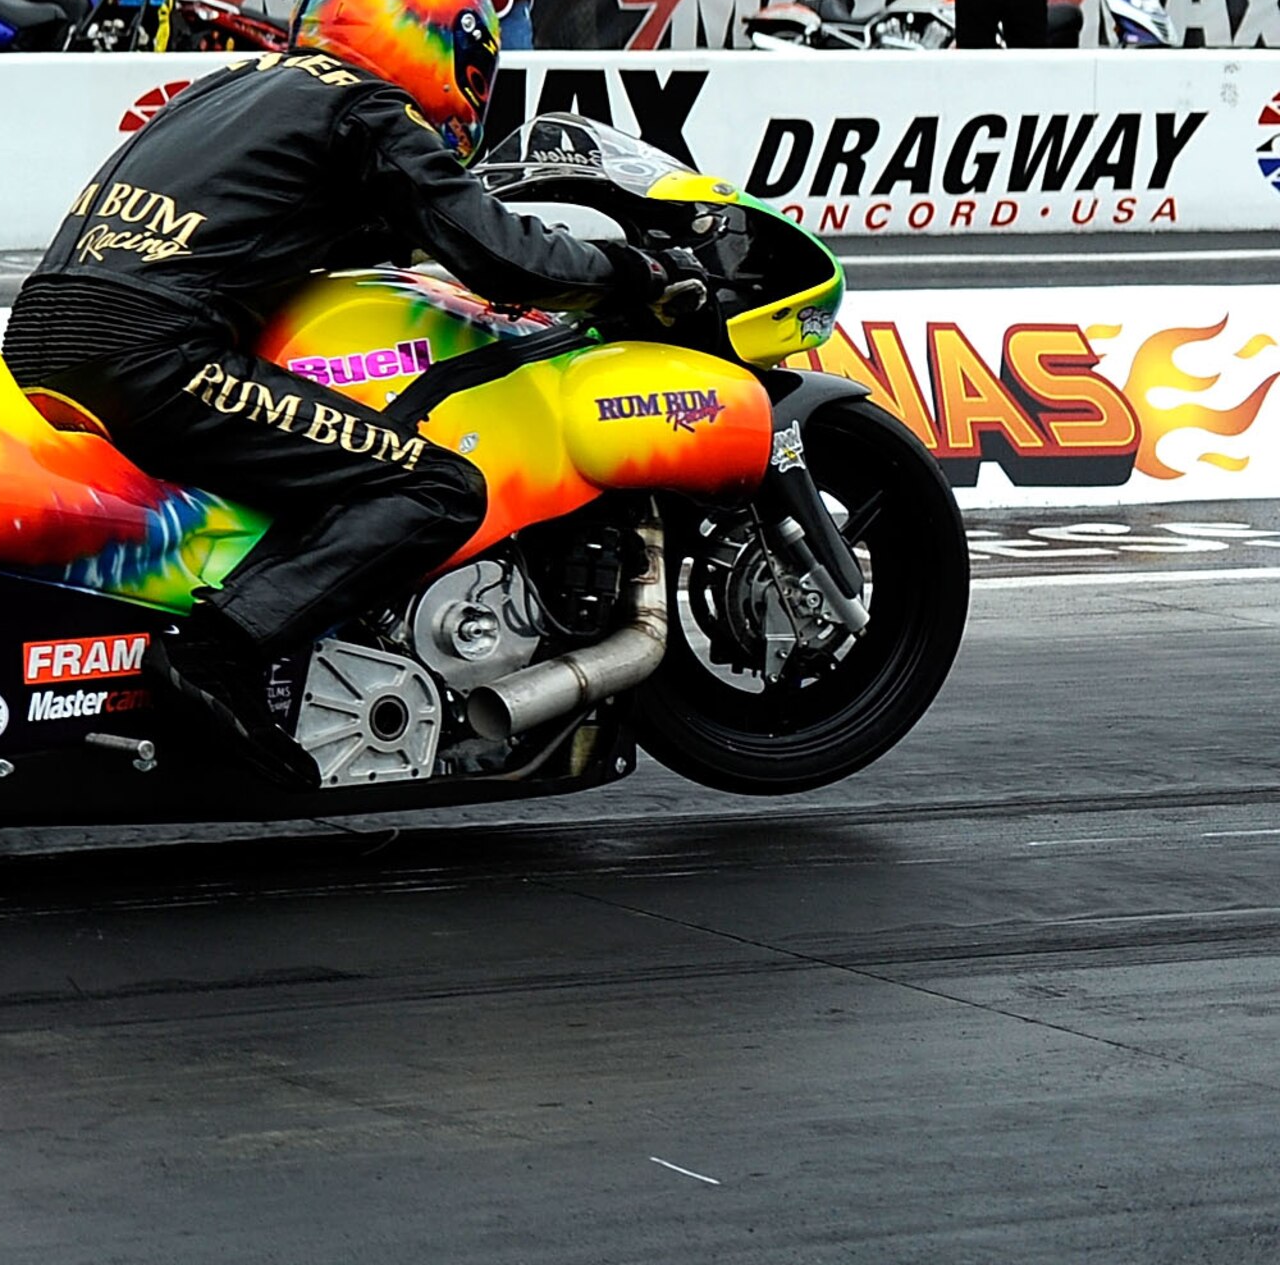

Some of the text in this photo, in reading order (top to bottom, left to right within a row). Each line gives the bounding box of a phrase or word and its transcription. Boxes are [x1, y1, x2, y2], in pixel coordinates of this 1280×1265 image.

[745, 112, 1209, 199] DRAGWAY
[97, 183, 208, 249] BUM
[1071, 197, 1177, 225] USA
[76, 223, 193, 263] Racing
[288, 338, 434, 387] Buell
[182, 363, 430, 471] RUM BUM
[595, 390, 718, 422] RUM BUM
[26, 637, 146, 680] FRAM
